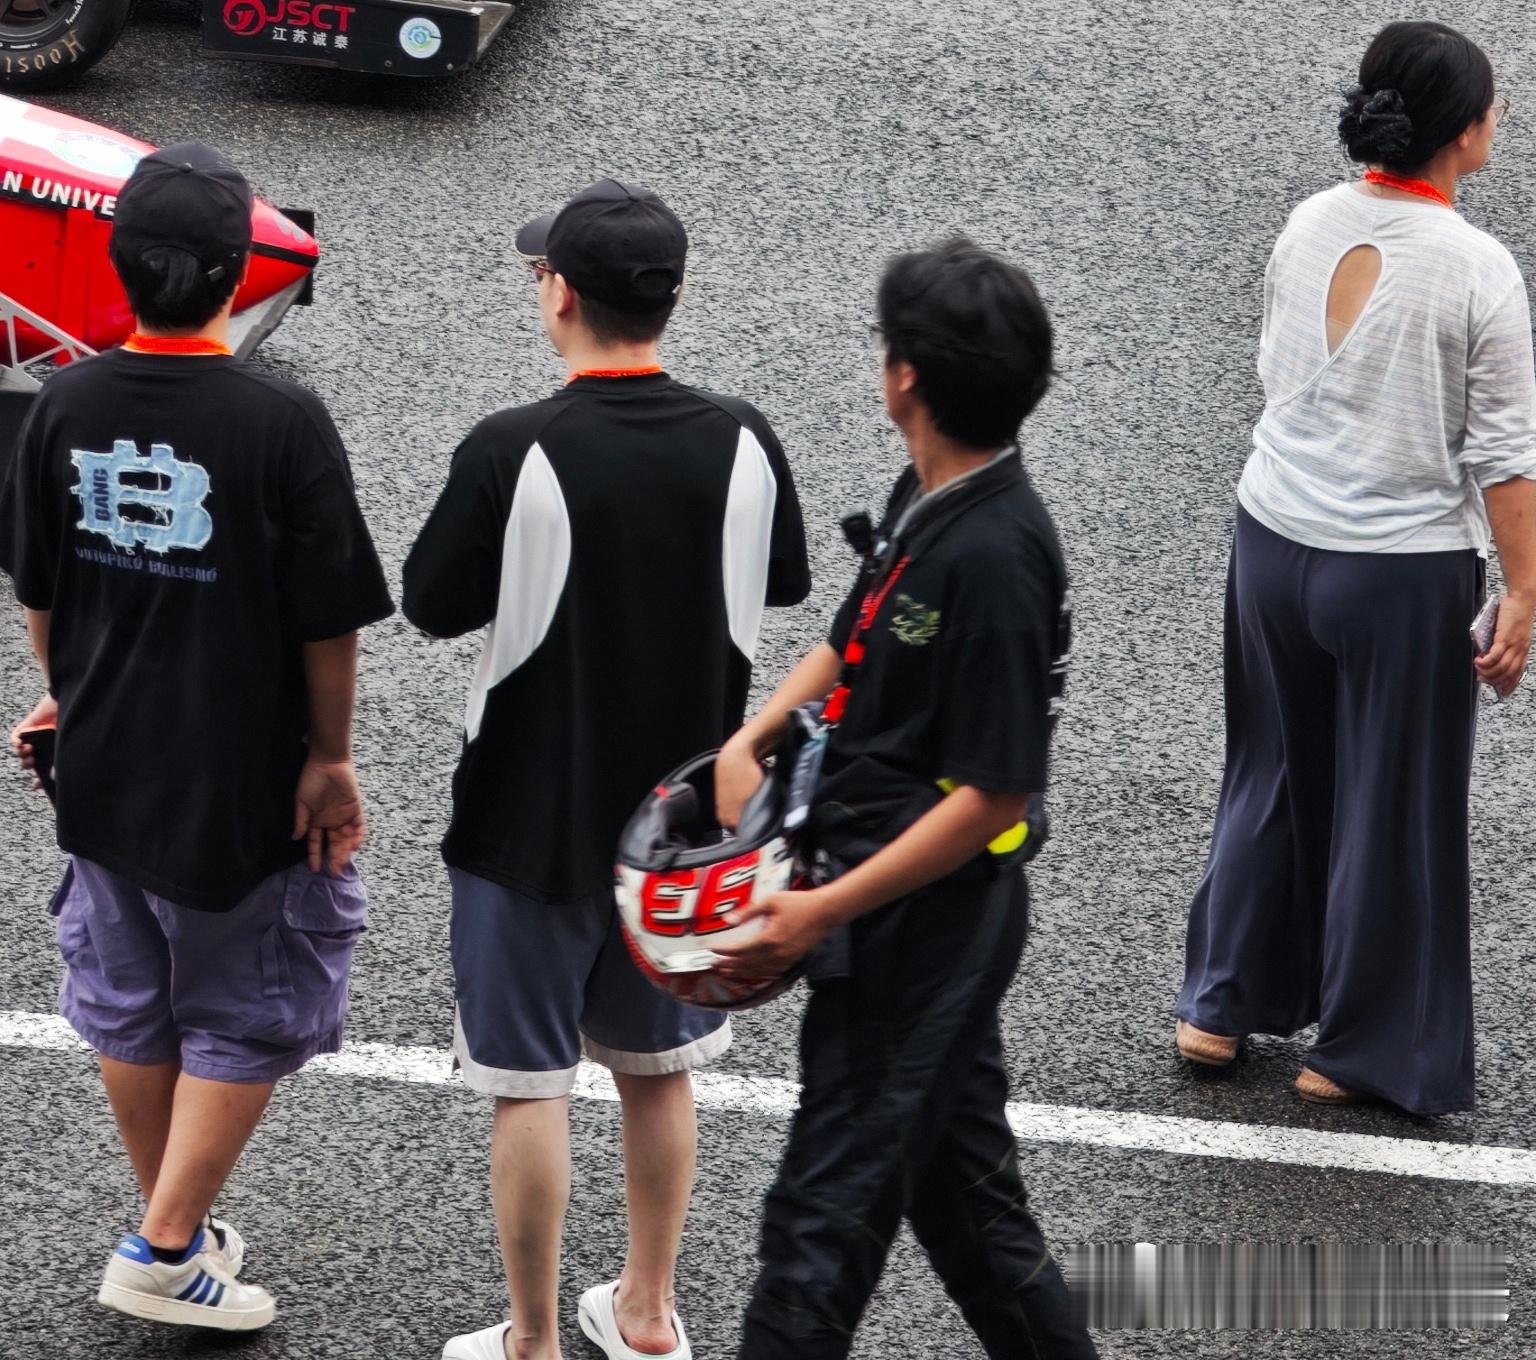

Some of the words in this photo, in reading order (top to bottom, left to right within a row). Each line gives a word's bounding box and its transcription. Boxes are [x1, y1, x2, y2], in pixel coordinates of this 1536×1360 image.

[272, 25, 350, 50] 江苏诚泰
[92, 468, 112, 522] BANG
